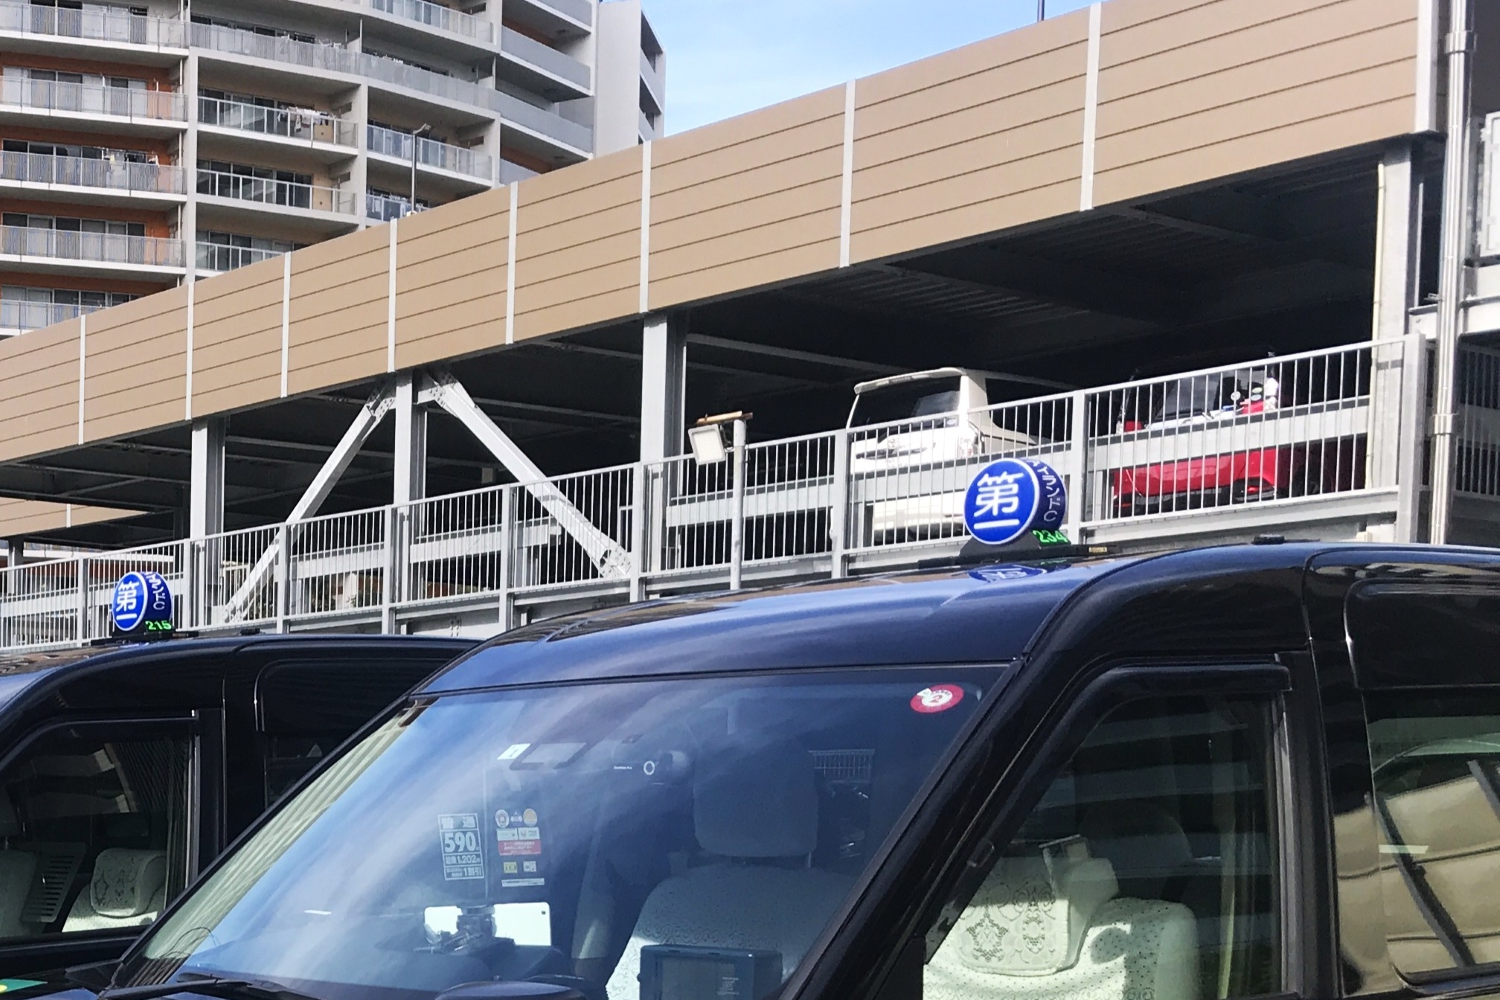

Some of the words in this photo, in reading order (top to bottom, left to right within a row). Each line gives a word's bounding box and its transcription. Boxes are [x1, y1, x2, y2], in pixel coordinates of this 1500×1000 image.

[973, 470, 1024, 530] 第一
[1032, 530, 1069, 543] 234
[115, 580, 140, 620] 第一
[145, 620, 172, 630] 215
